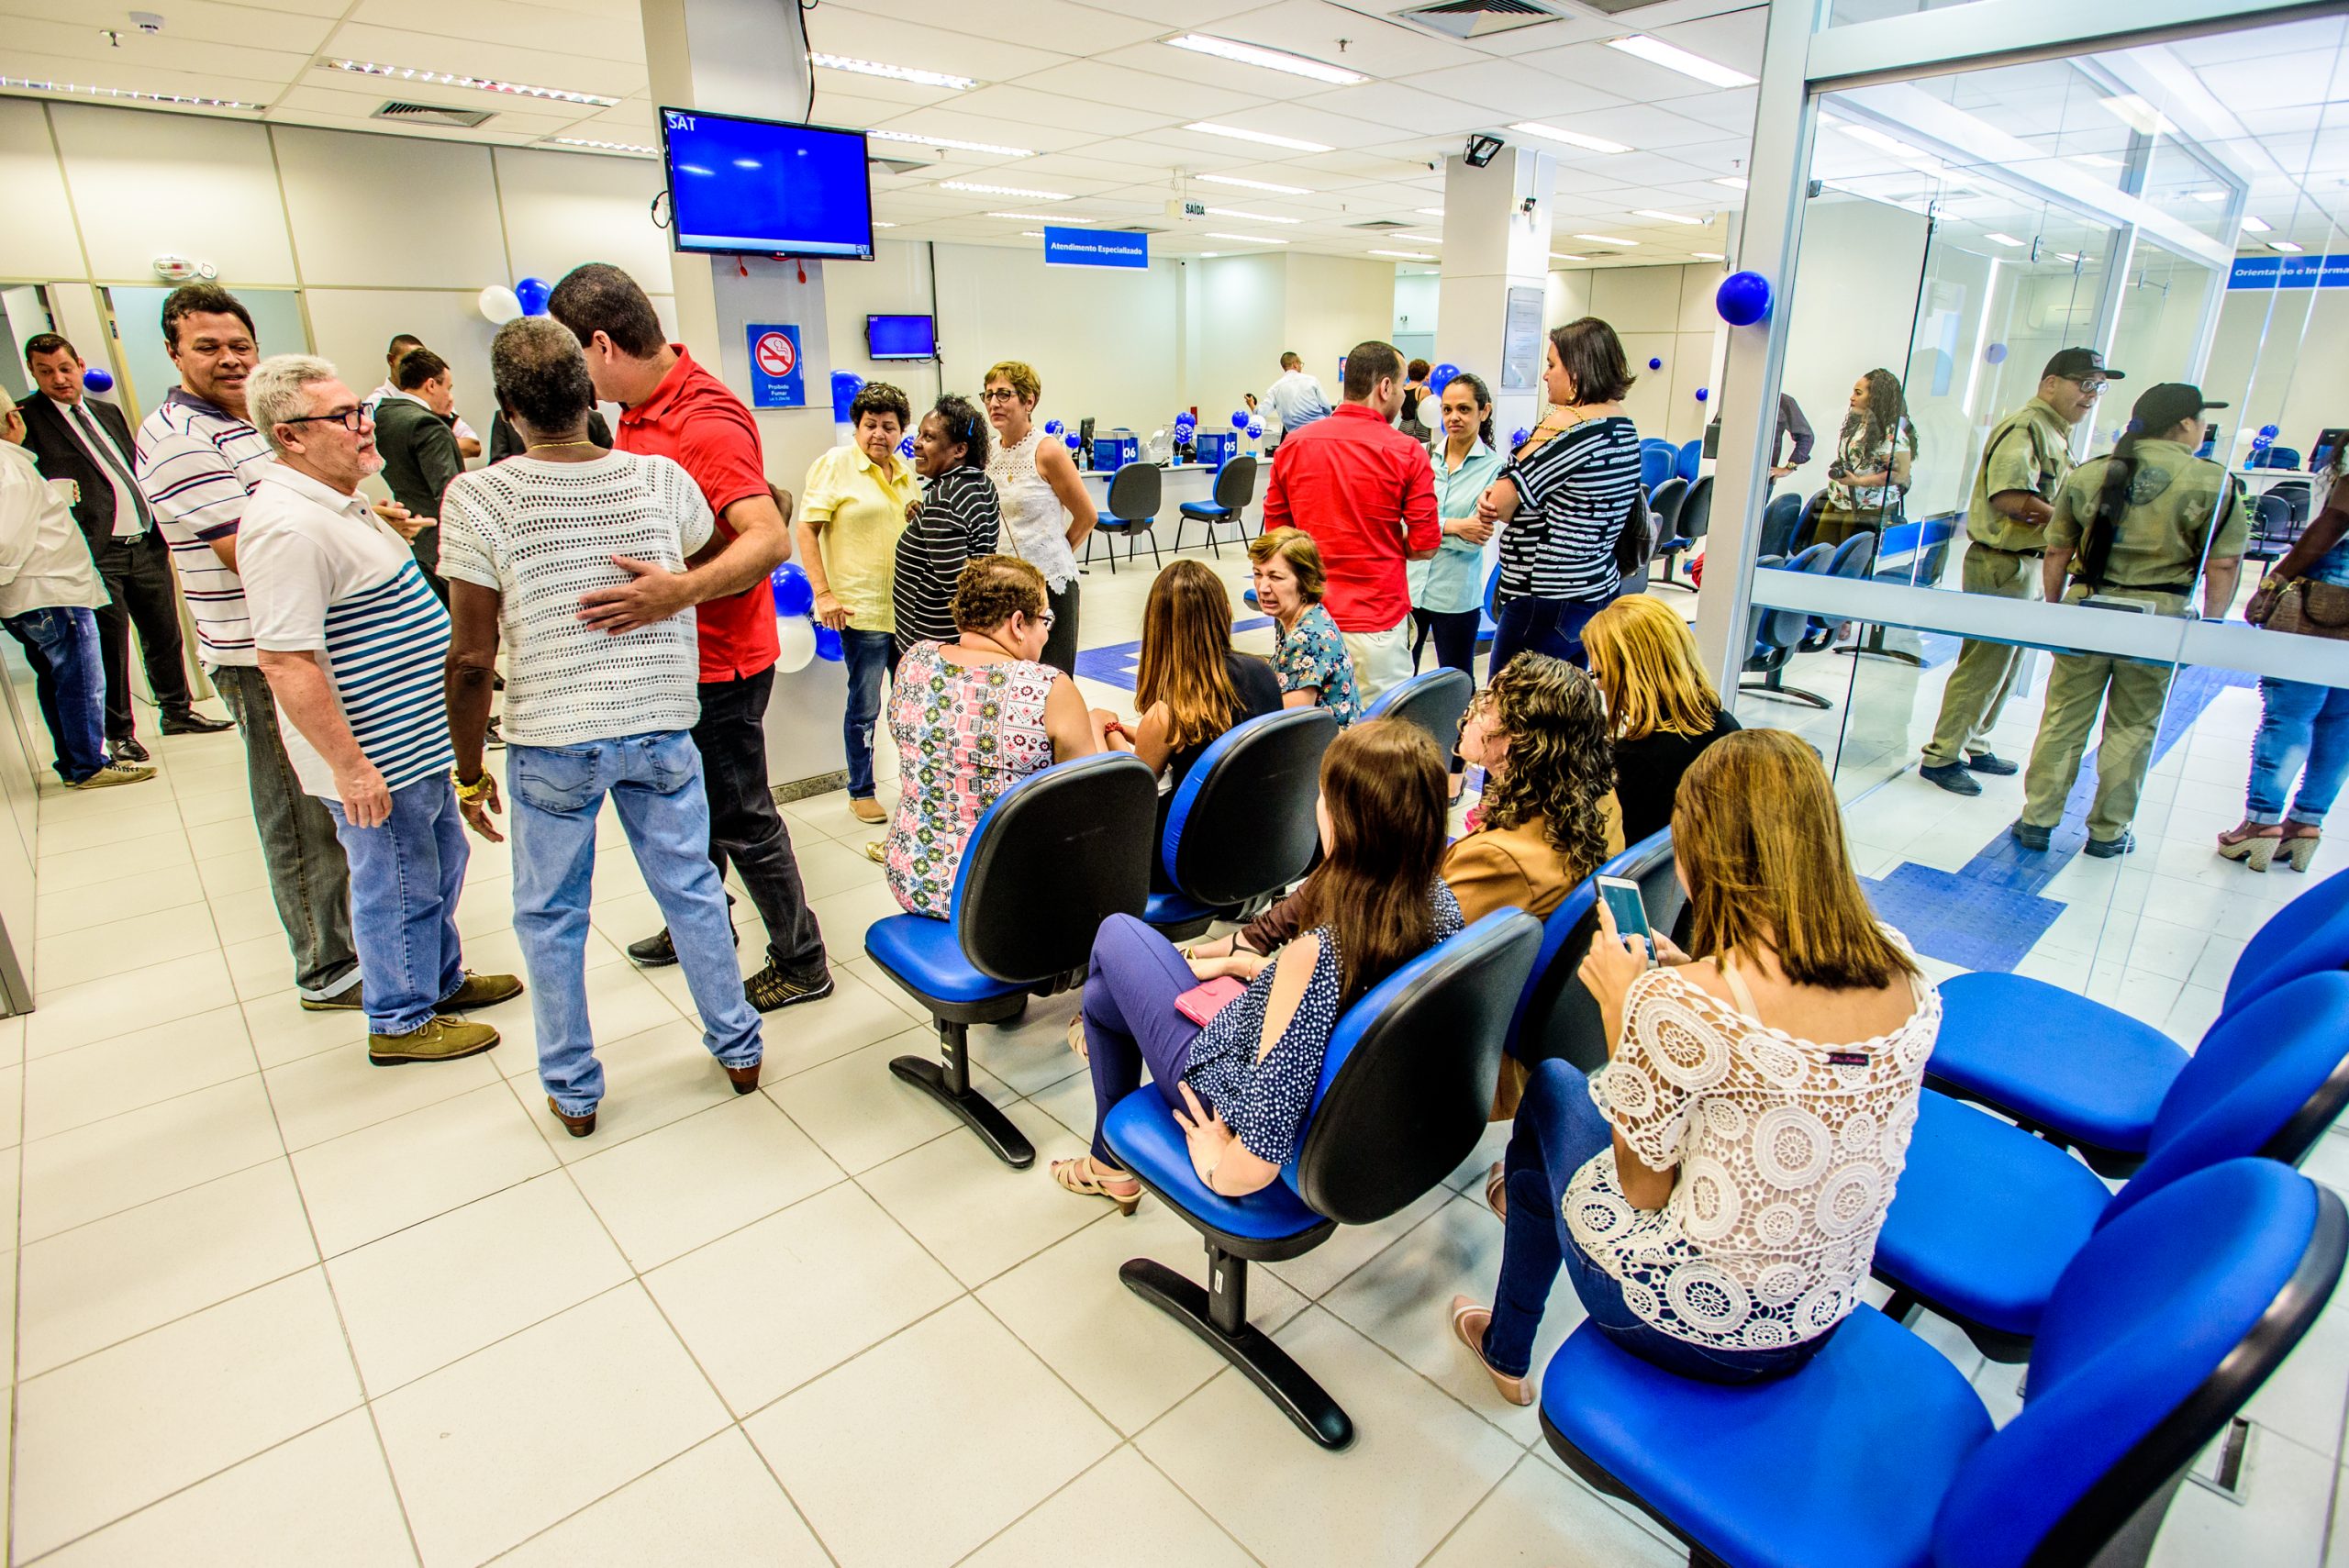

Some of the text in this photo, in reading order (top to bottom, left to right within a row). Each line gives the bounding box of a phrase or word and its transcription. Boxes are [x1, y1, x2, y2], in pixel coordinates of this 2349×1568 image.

[668, 116, 696, 131] SAT
[1186, 203, 1205, 216] SAÍDA
[1051, 242, 1143, 256] Atendimento Especializado
[1123, 448, 1136, 458] 06
[1224, 442, 1235, 451] 05
